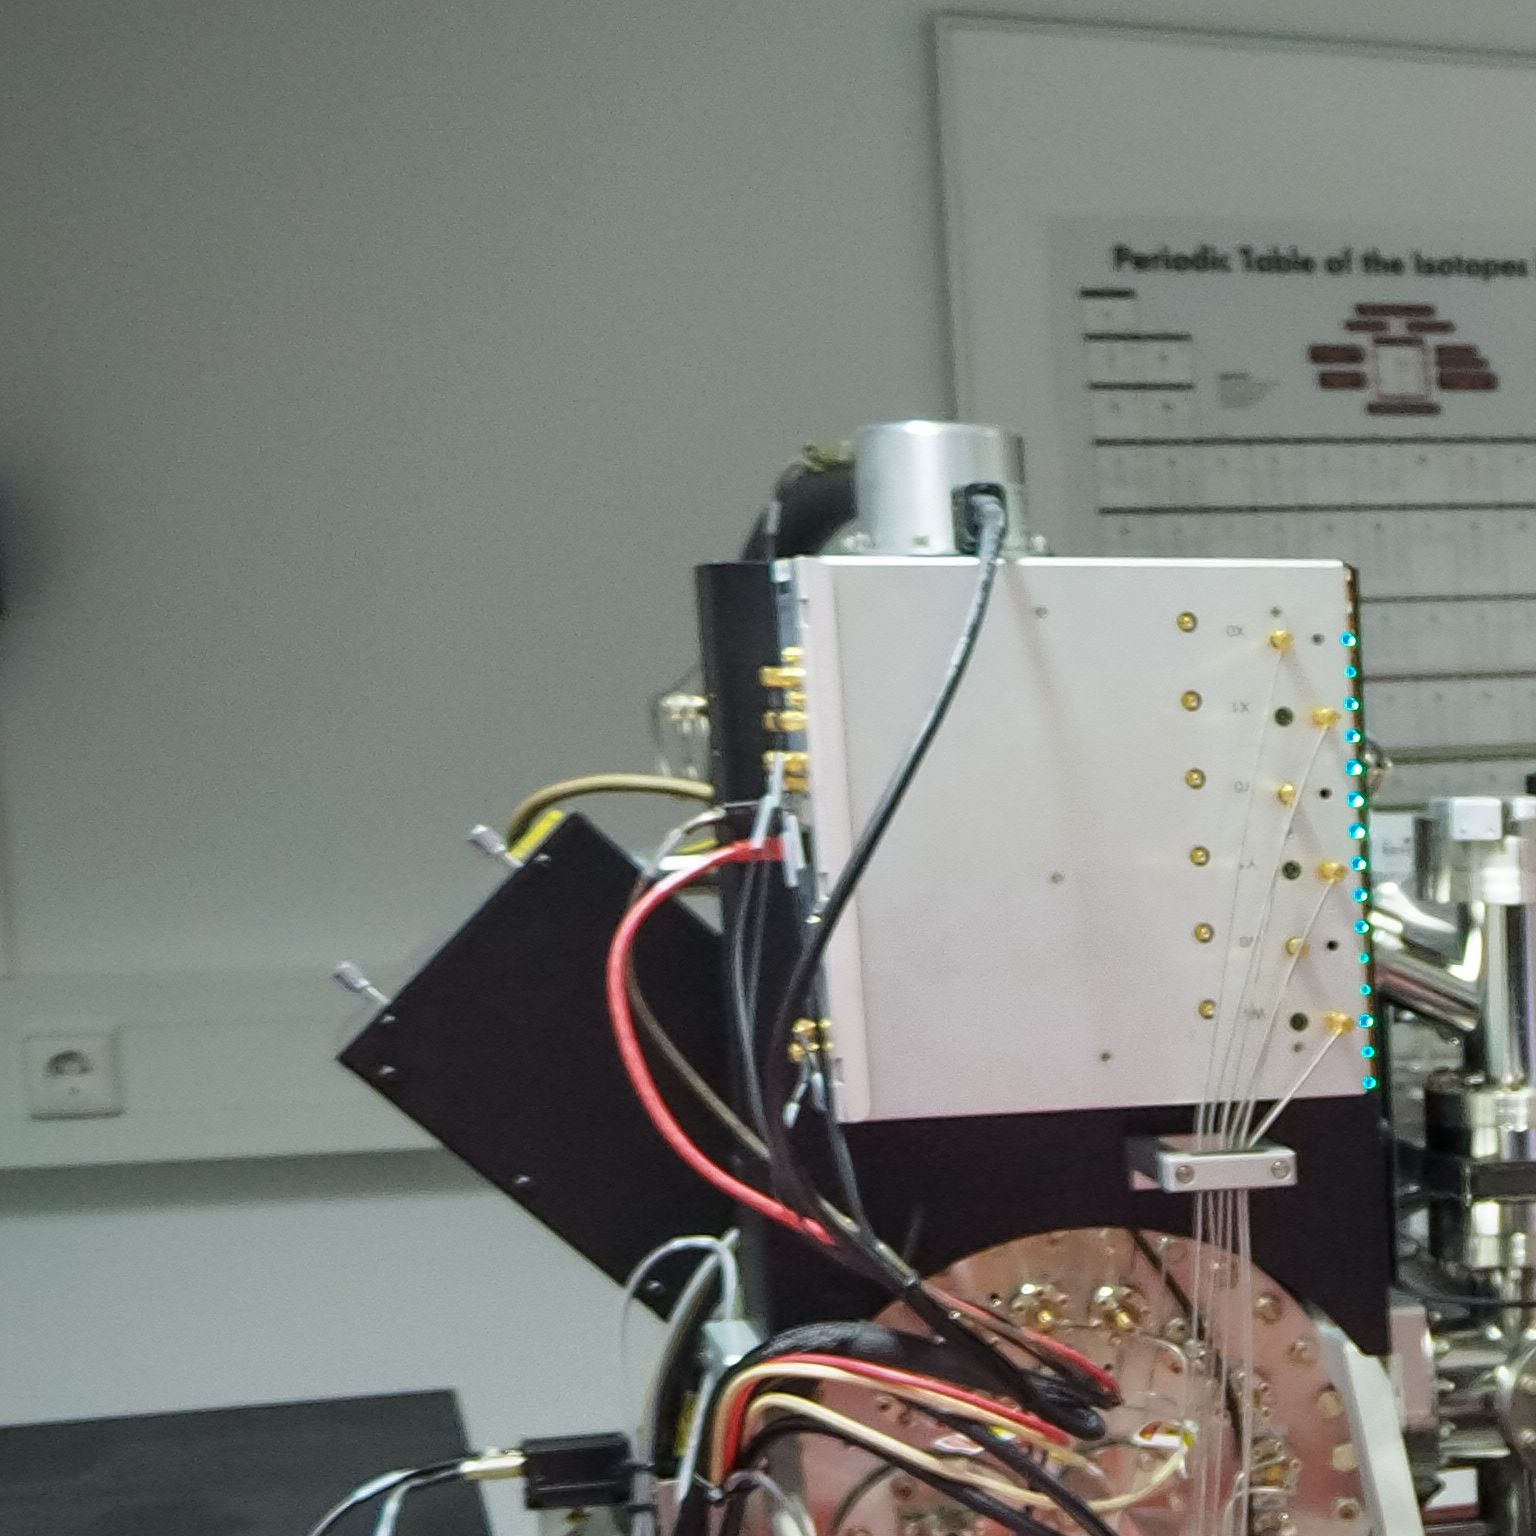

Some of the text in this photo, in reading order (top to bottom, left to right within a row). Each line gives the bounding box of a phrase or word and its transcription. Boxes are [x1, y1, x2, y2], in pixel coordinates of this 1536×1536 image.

[1113, 244, 1231, 273] Periodic
[1239, 245, 1317, 275] Table
[1324, 246, 1353, 274] of
[1363, 245, 1405, 275] the
[1413, 249, 1528, 282] Isotopes
